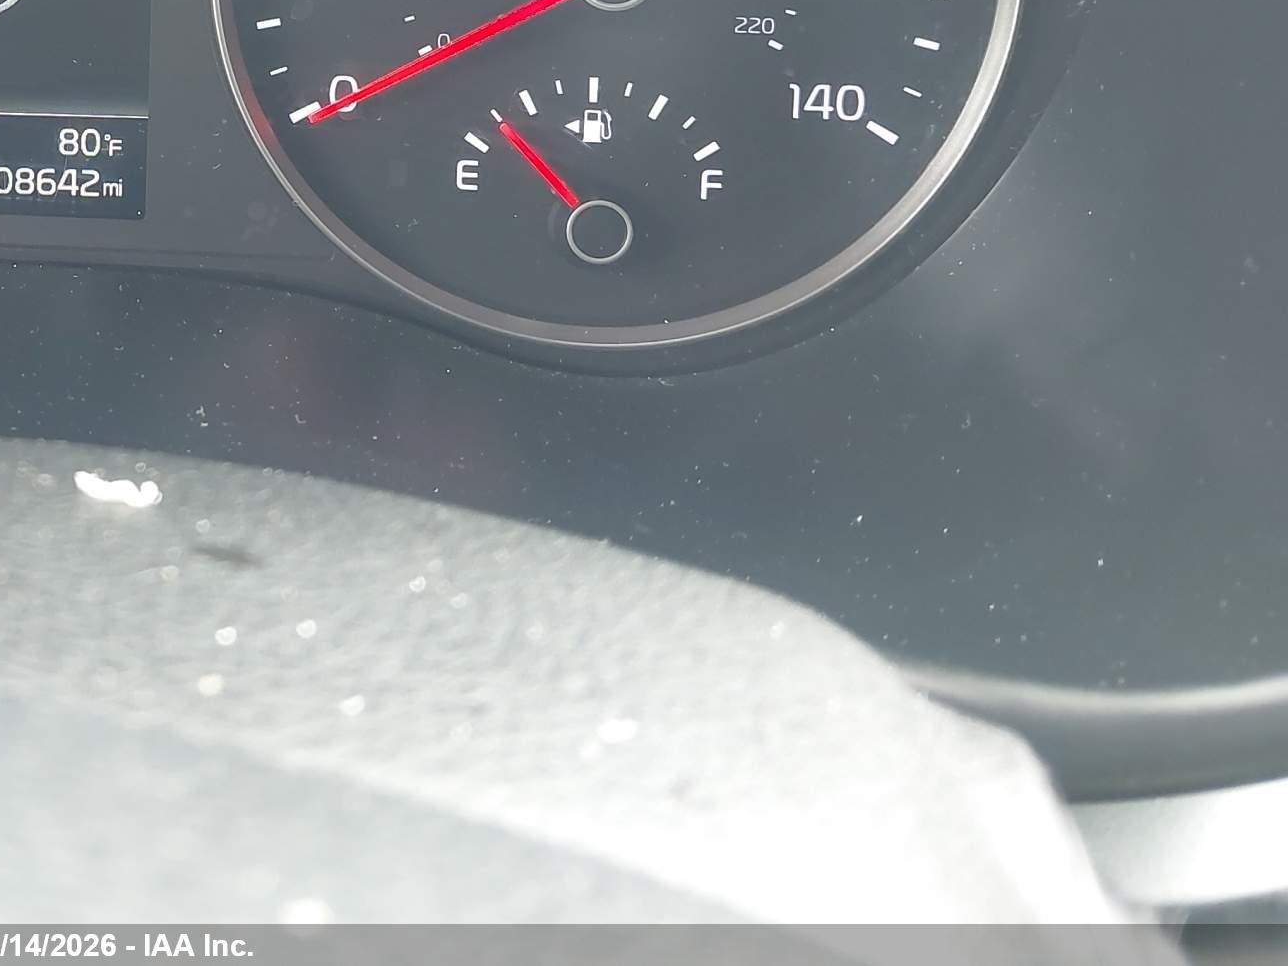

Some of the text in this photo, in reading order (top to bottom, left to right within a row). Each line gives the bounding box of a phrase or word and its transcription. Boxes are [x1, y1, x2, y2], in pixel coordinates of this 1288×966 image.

[735, 17, 774, 34] 220
[329, 75, 359, 112] 0
[790, 84, 864, 120] 140
[457, 160, 478, 190] E
[701, 170, 722, 199] F
